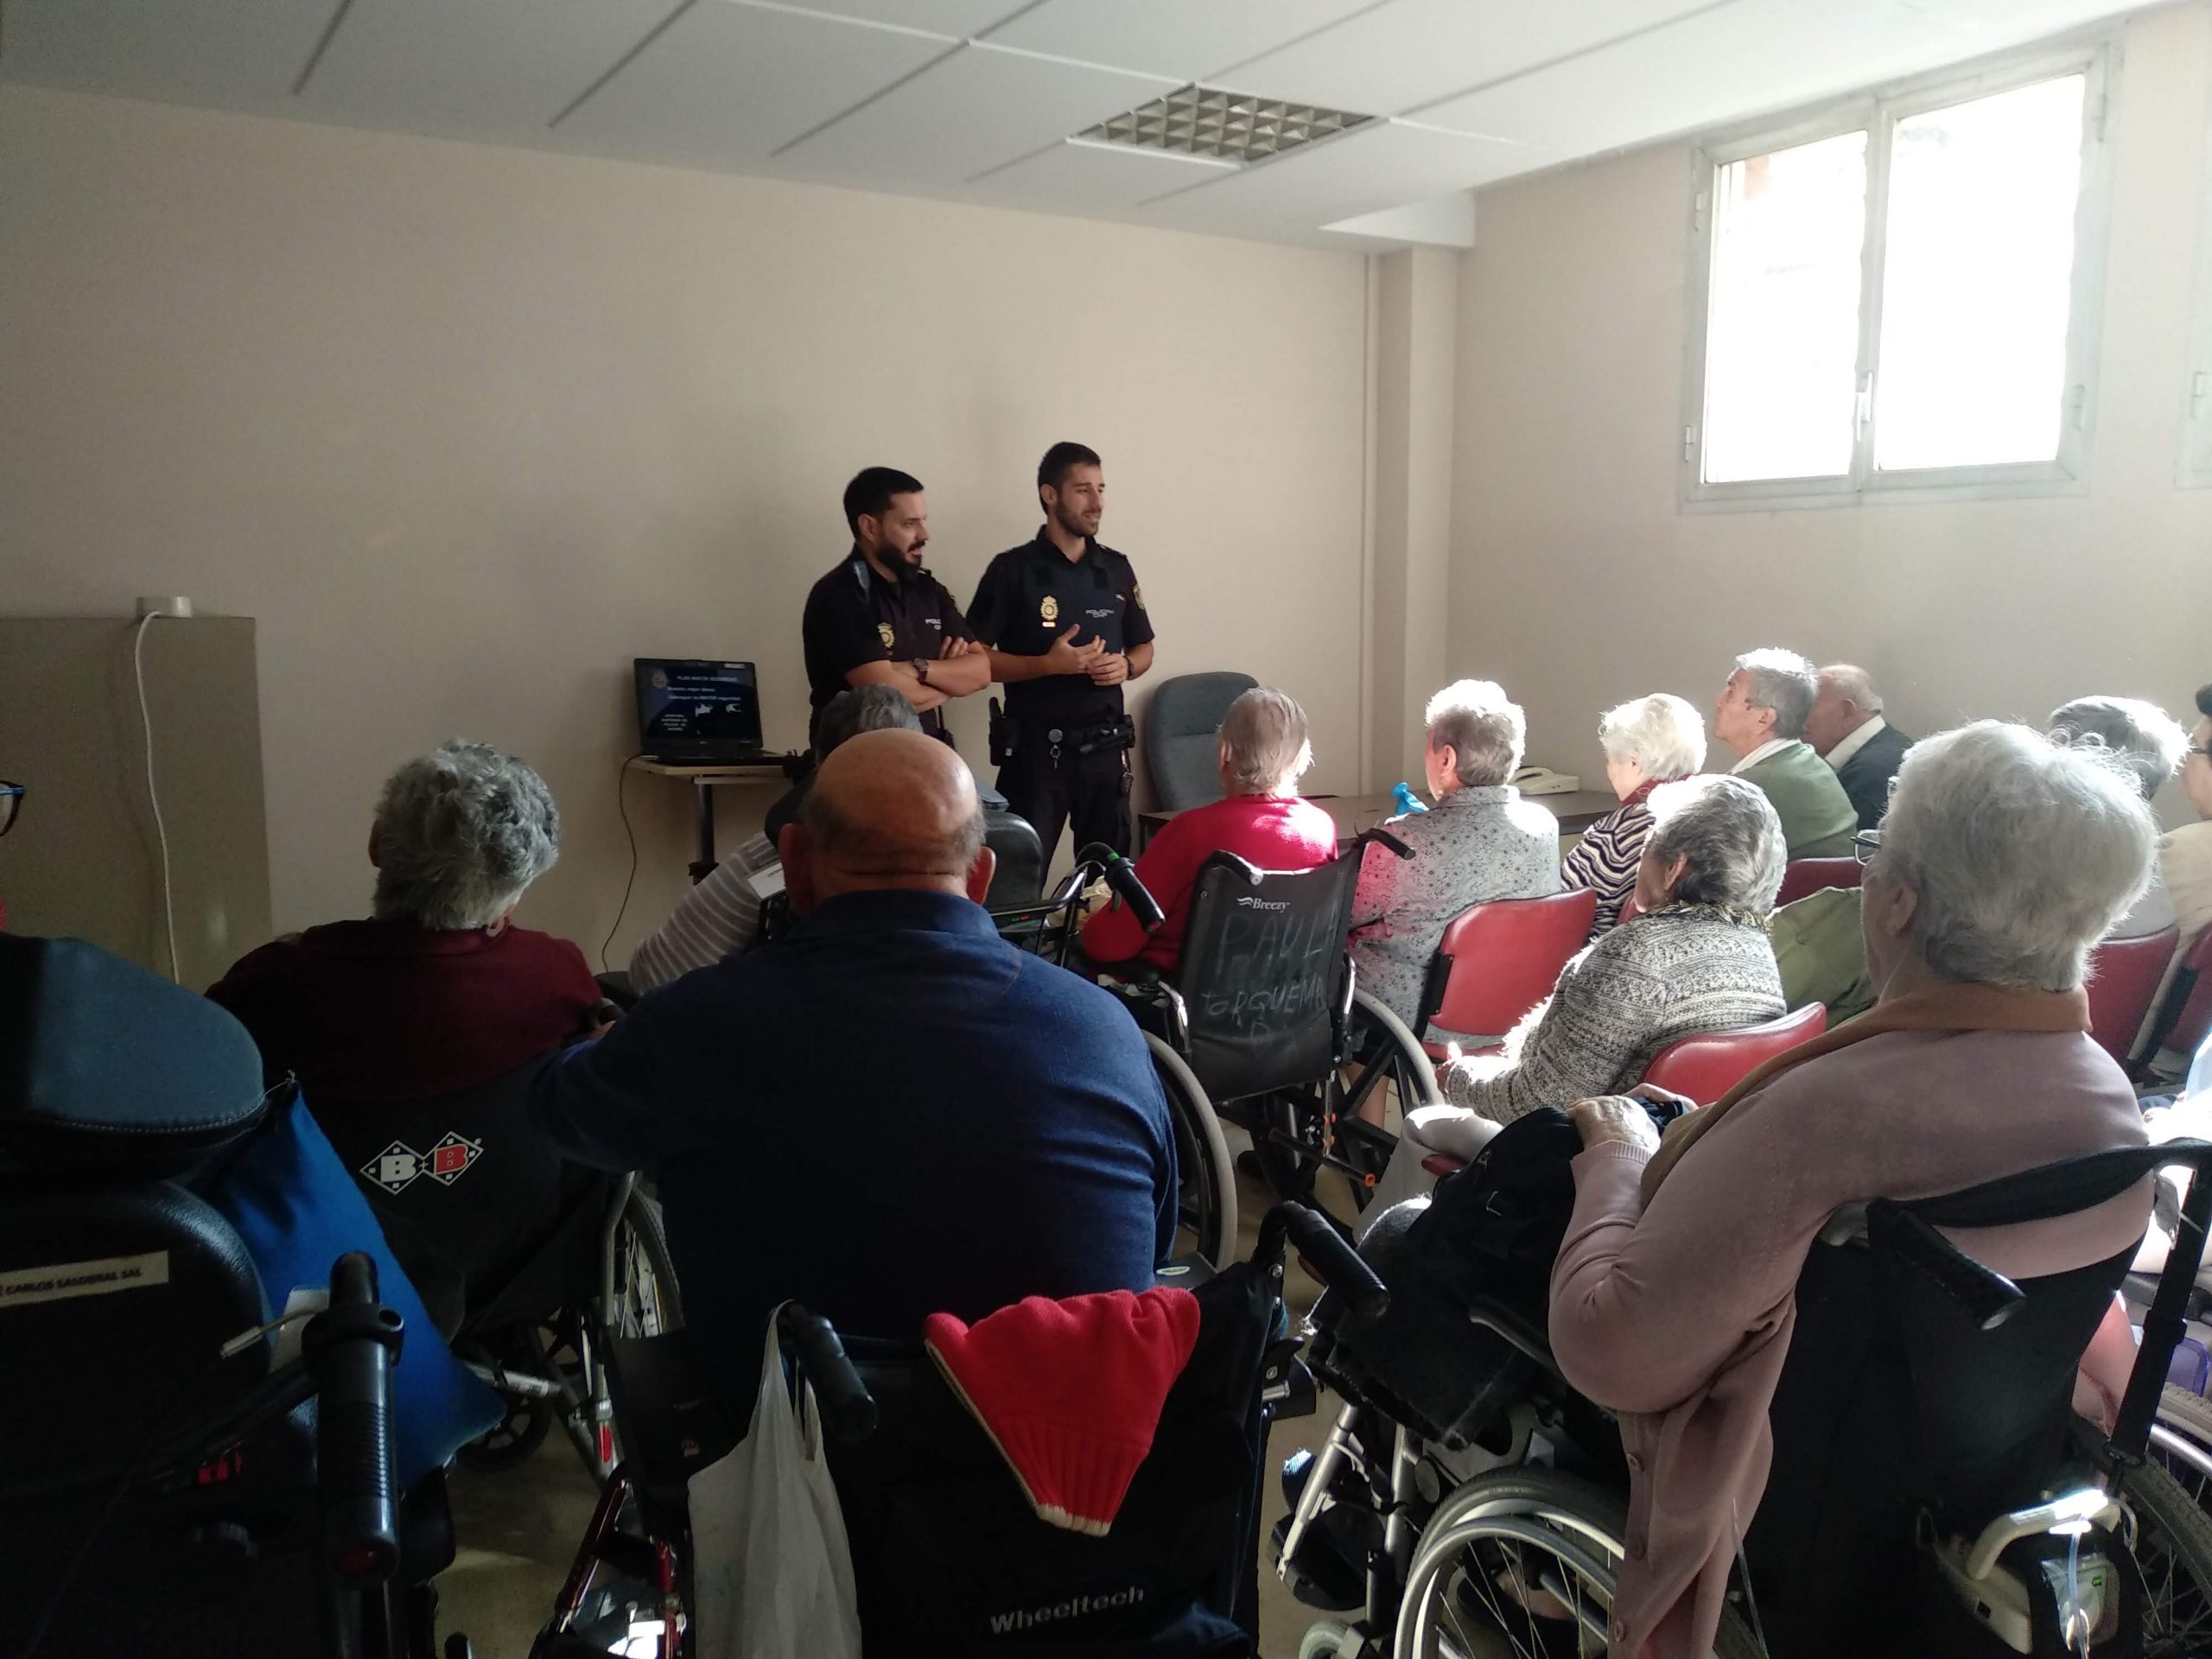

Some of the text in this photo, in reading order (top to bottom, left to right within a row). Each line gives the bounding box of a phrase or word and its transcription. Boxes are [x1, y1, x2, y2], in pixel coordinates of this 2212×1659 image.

[1253, 898, 1287, 913] Breezy
[6, 1279, 54, 1294] CARLOS
[989, 1586, 1145, 1636] Wheeltech
